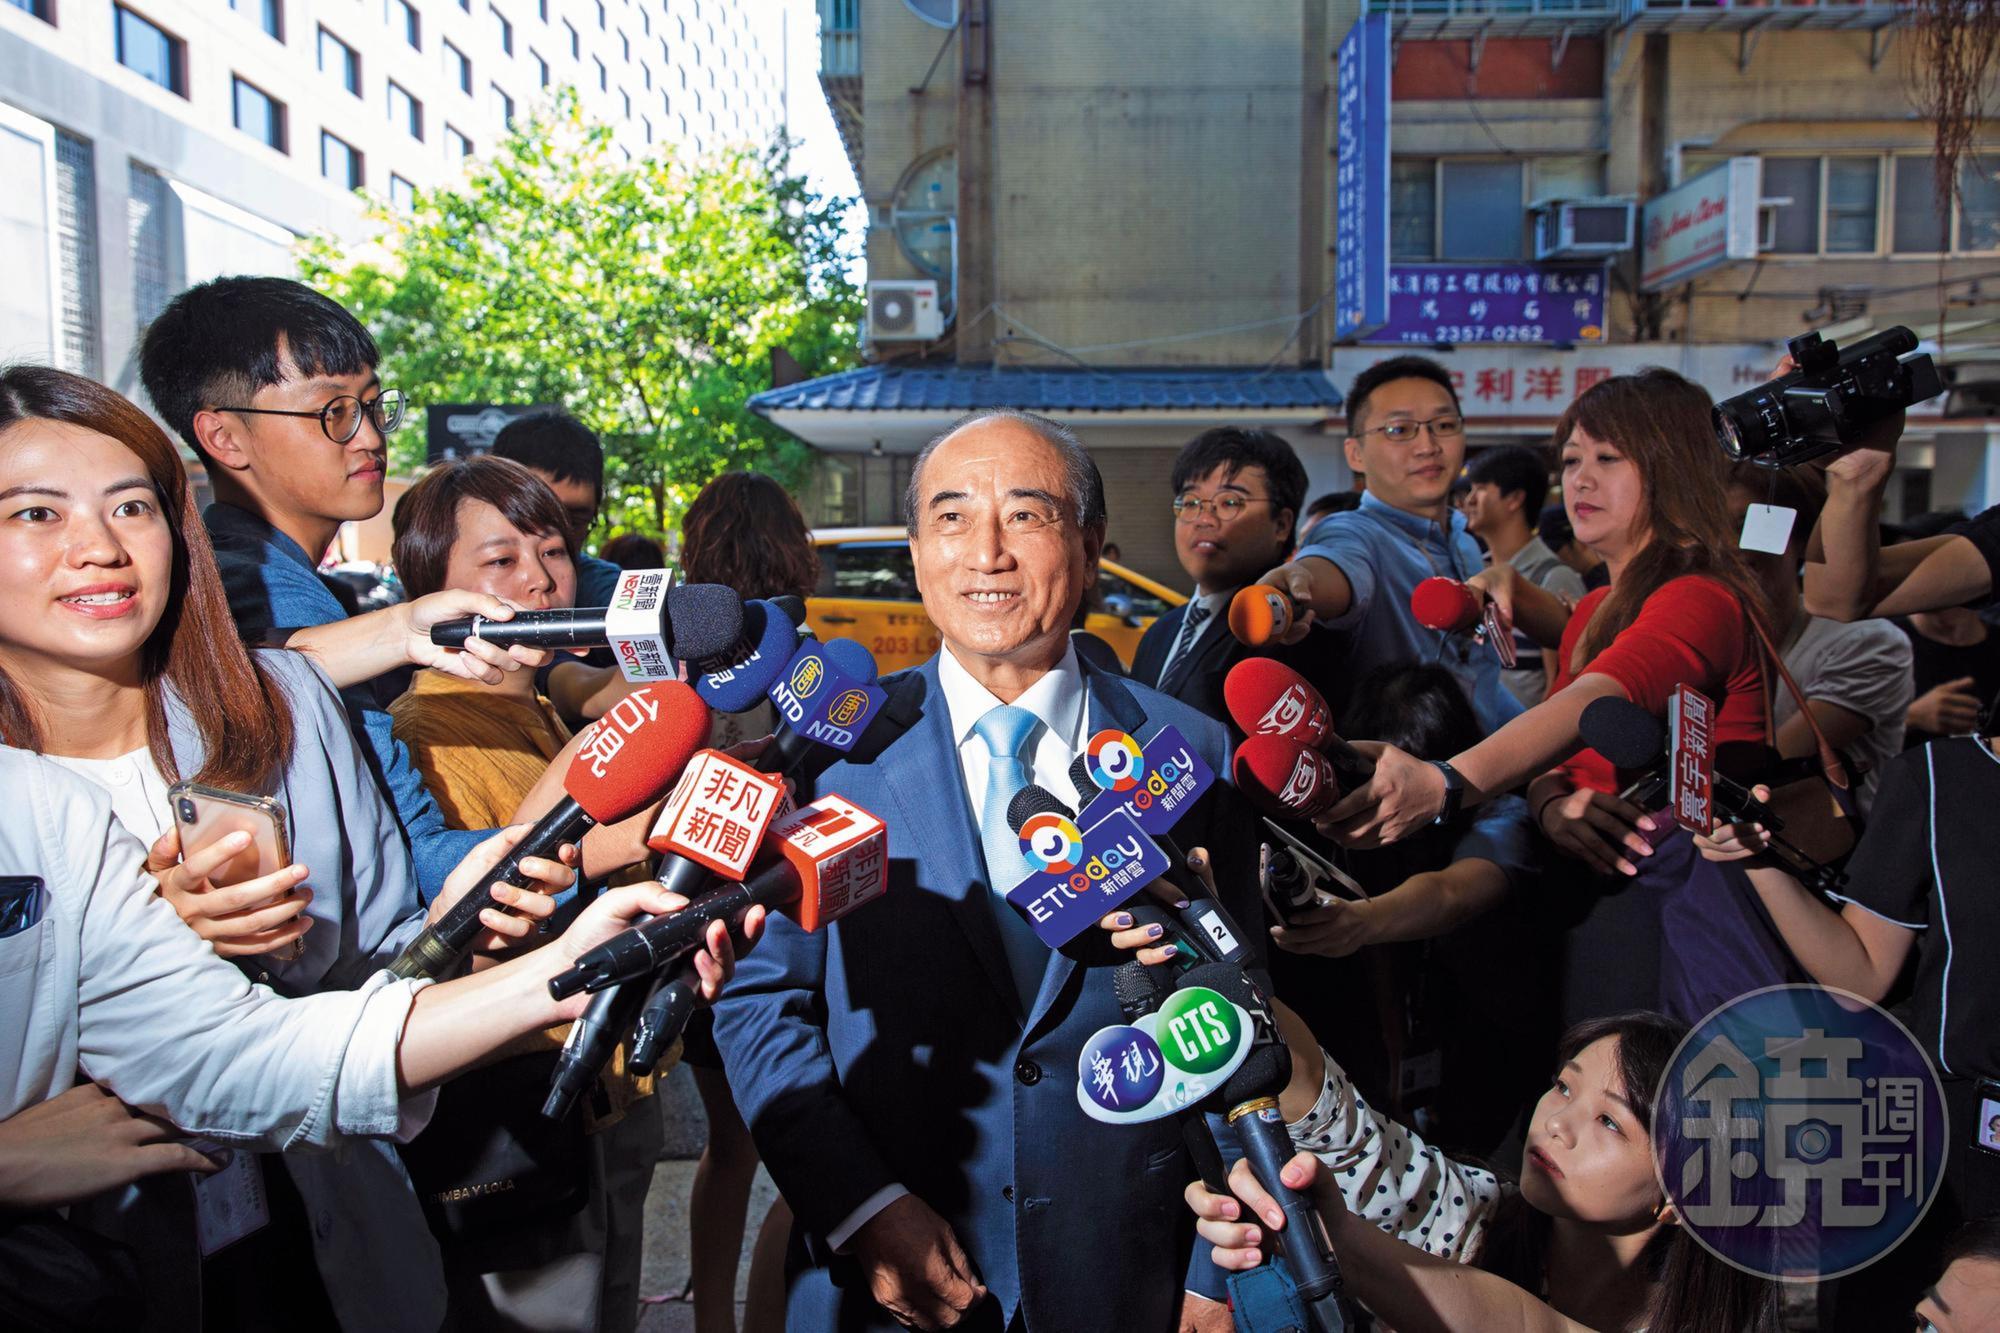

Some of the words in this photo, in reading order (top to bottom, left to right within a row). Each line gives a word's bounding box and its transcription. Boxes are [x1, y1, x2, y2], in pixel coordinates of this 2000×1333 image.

[772, 682, 804, 723] NTD
[806, 720, 853, 746] NTD
[1679, 690, 1708, 829] 寰宇新聞
[703, 767, 764, 824] 非凡
[1124, 747, 1195, 818] today
[1159, 772, 1198, 812] 新聞雲
[683, 805, 753, 864] 新聞
[854, 845, 881, 900] 非凡
[1026, 834, 1145, 924] ETtoday
[1099, 860, 1147, 897] 新聞雲
[1212, 925, 1227, 941] 2
[1167, 1000, 1232, 1063] CTS
[1089, 1040, 1160, 1107] 華視
[484, 1179, 515, 1195] LOLA
